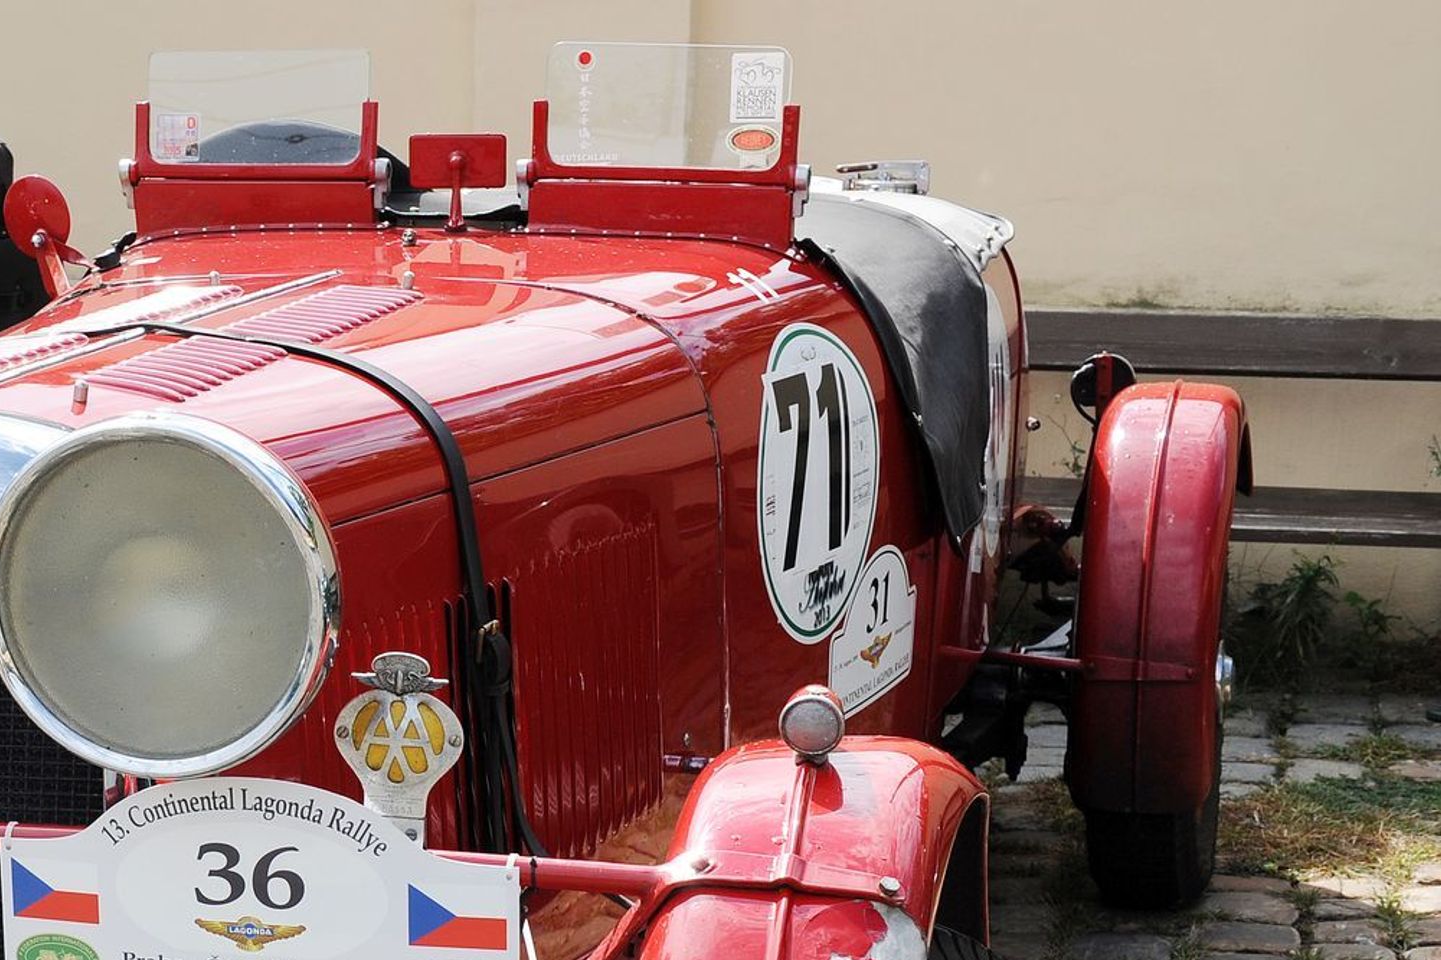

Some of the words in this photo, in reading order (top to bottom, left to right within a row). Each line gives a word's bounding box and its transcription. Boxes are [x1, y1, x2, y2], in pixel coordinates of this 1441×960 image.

[736, 88, 776, 97] KLAUSEN
[736, 97, 776, 105] RENNEN
[866, 571, 890, 634] 31
[100, 818, 130, 846] 13.
[128, 787, 235, 829] Continental
[241, 787, 323, 821] Lagonda
[327, 806, 388, 857] Rallye
[194, 842, 305, 910] 36
[228, 925, 274, 937] LAGONDA
